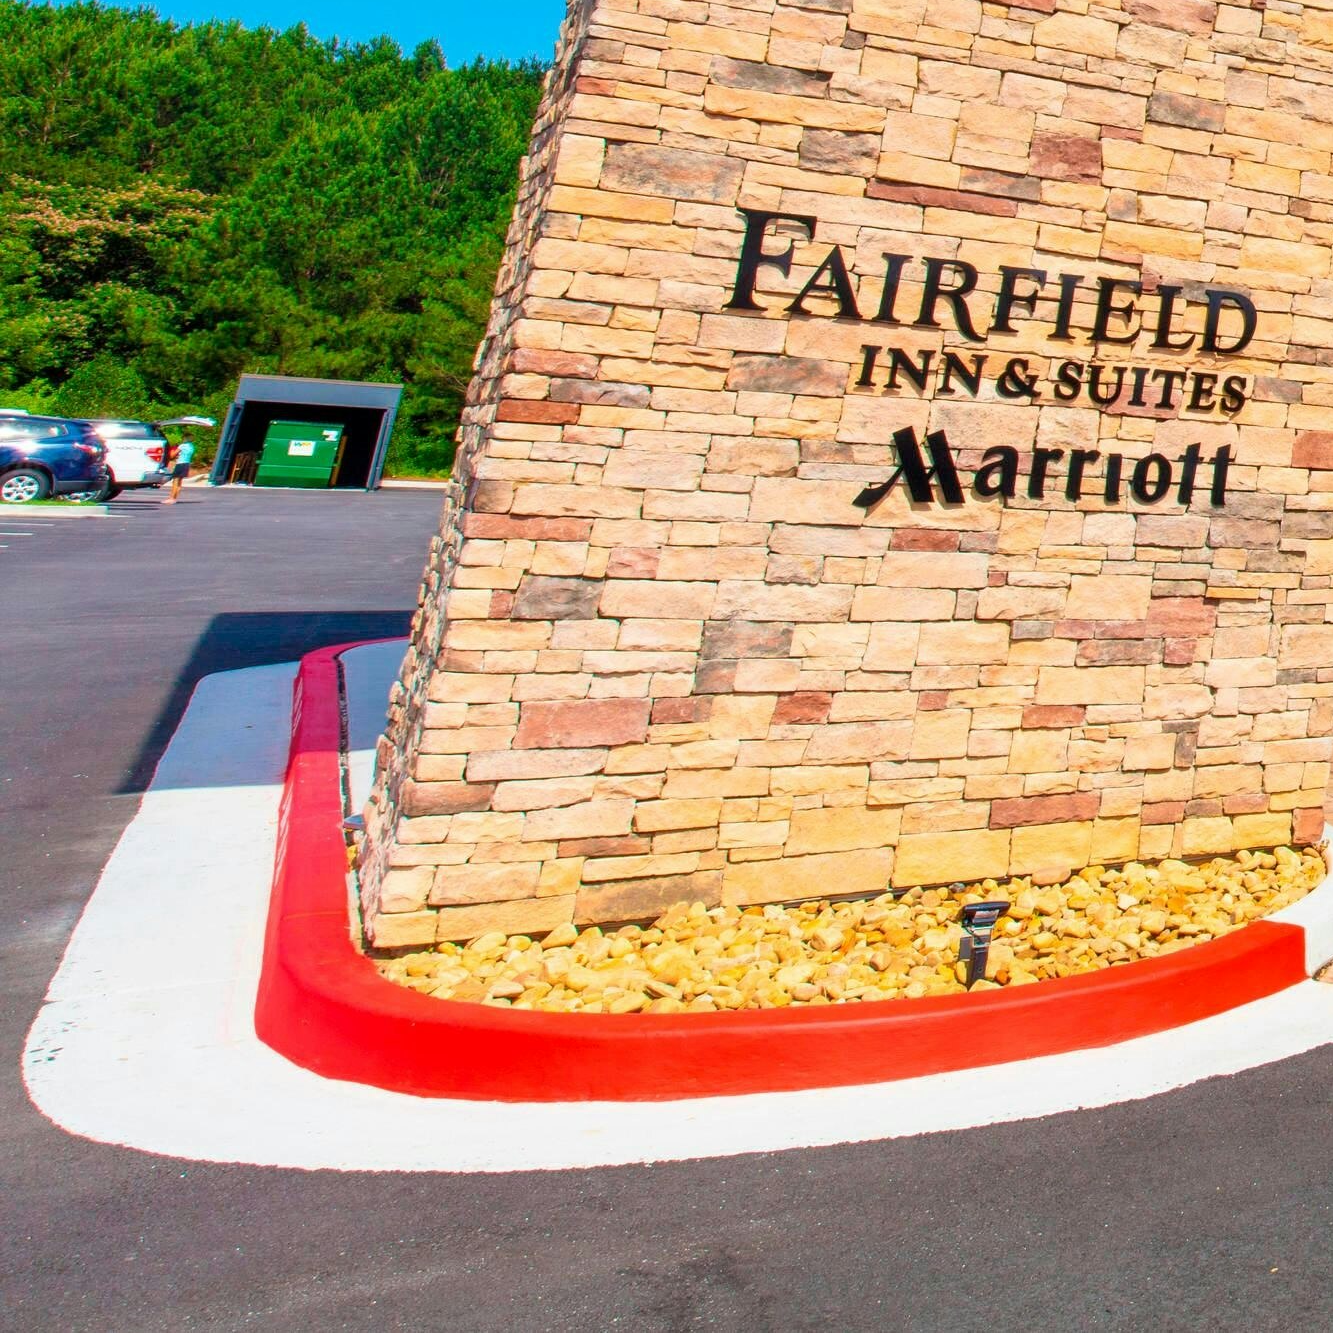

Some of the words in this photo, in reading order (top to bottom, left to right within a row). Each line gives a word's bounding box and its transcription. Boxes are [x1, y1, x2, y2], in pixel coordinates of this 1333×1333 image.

[722, 207, 1258, 354] FAIRFIELD
[854, 344, 988, 396] INN
[997, 357, 1040, 398] &
[1054, 360, 1248, 413] SUITES
[852, 425, 1236, 507] Marriott
